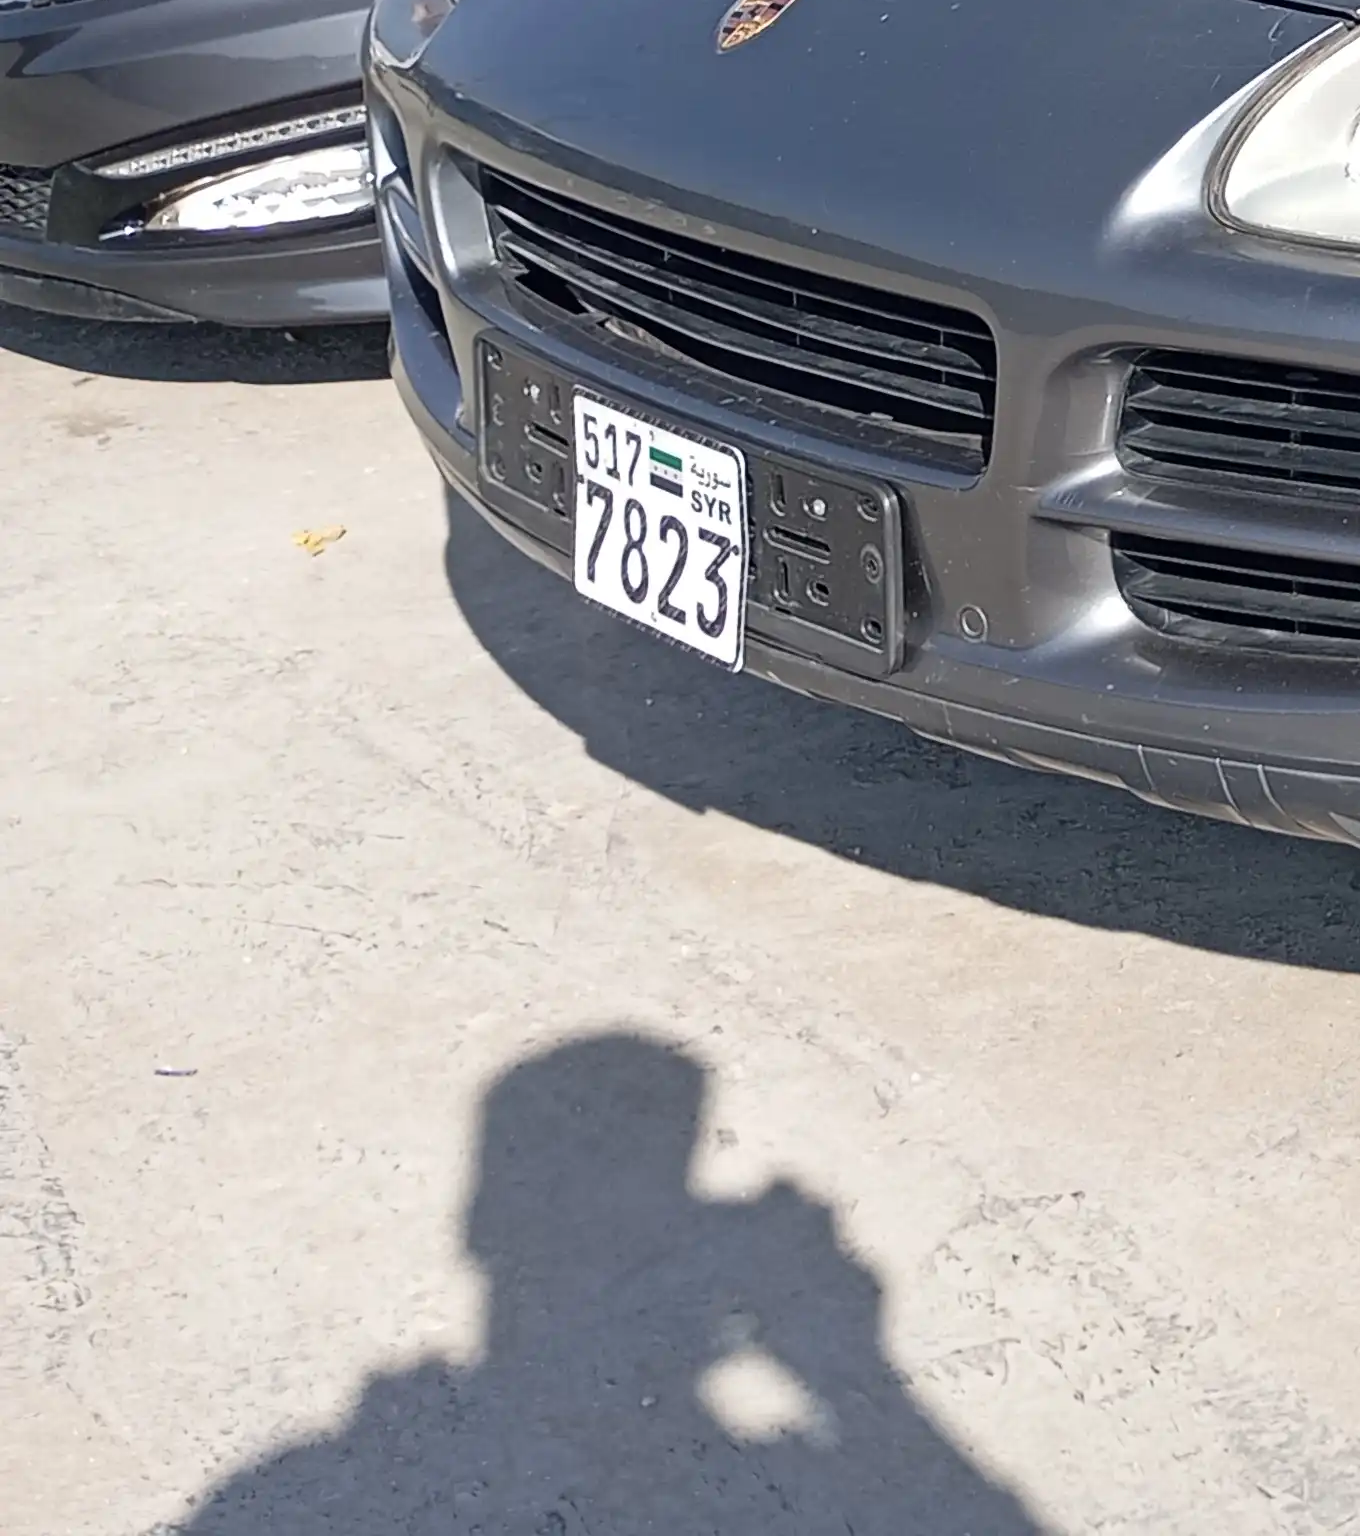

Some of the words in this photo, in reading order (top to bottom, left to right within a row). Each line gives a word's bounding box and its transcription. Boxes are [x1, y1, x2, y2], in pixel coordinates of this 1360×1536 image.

[583, 413, 642, 486] 517
[689, 455, 731, 489] سورية
[690, 490, 732, 525] SYR
[587, 479, 730, 638] 7823
